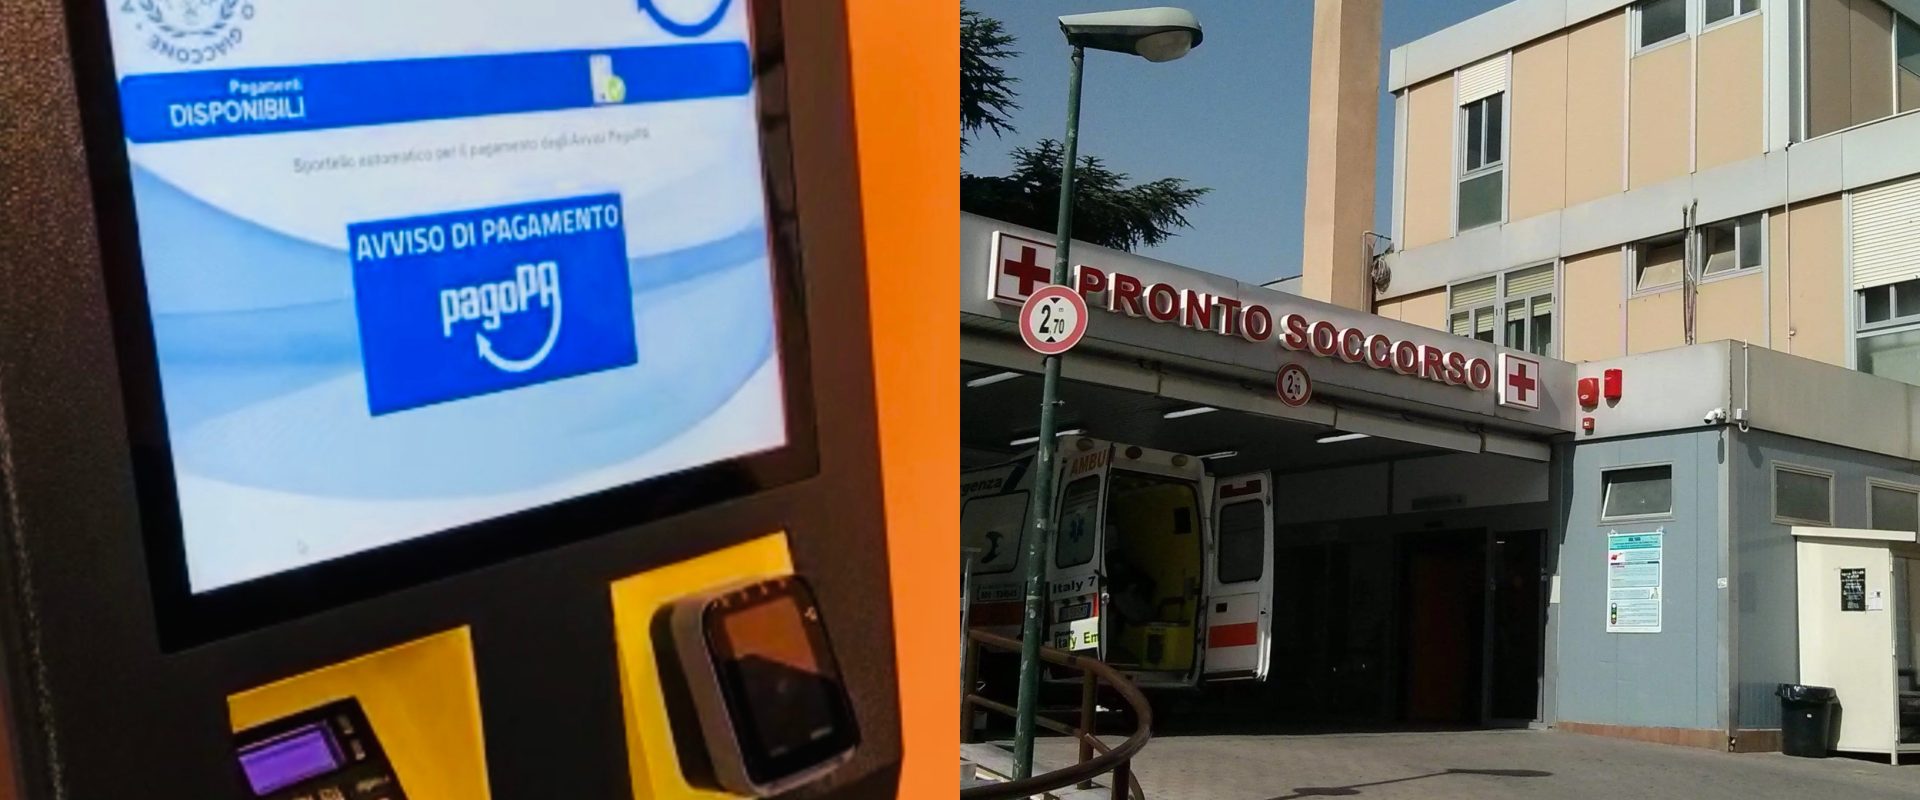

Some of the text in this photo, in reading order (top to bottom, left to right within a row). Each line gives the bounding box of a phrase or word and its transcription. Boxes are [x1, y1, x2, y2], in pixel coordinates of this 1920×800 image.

[150, 27, 243, 64] GIACCONE
[169, 95, 306, 128] DISPONIBILI
[356, 203, 619, 262] AVVISO DI PAGAMENTO
[440, 261, 562, 338] pagoPA
[1074, 264, 1491, 391] PRONTO SOCCORSO
[1053, 580, 1084, 594] Italy
[1055, 636, 1077, 649] Italy
